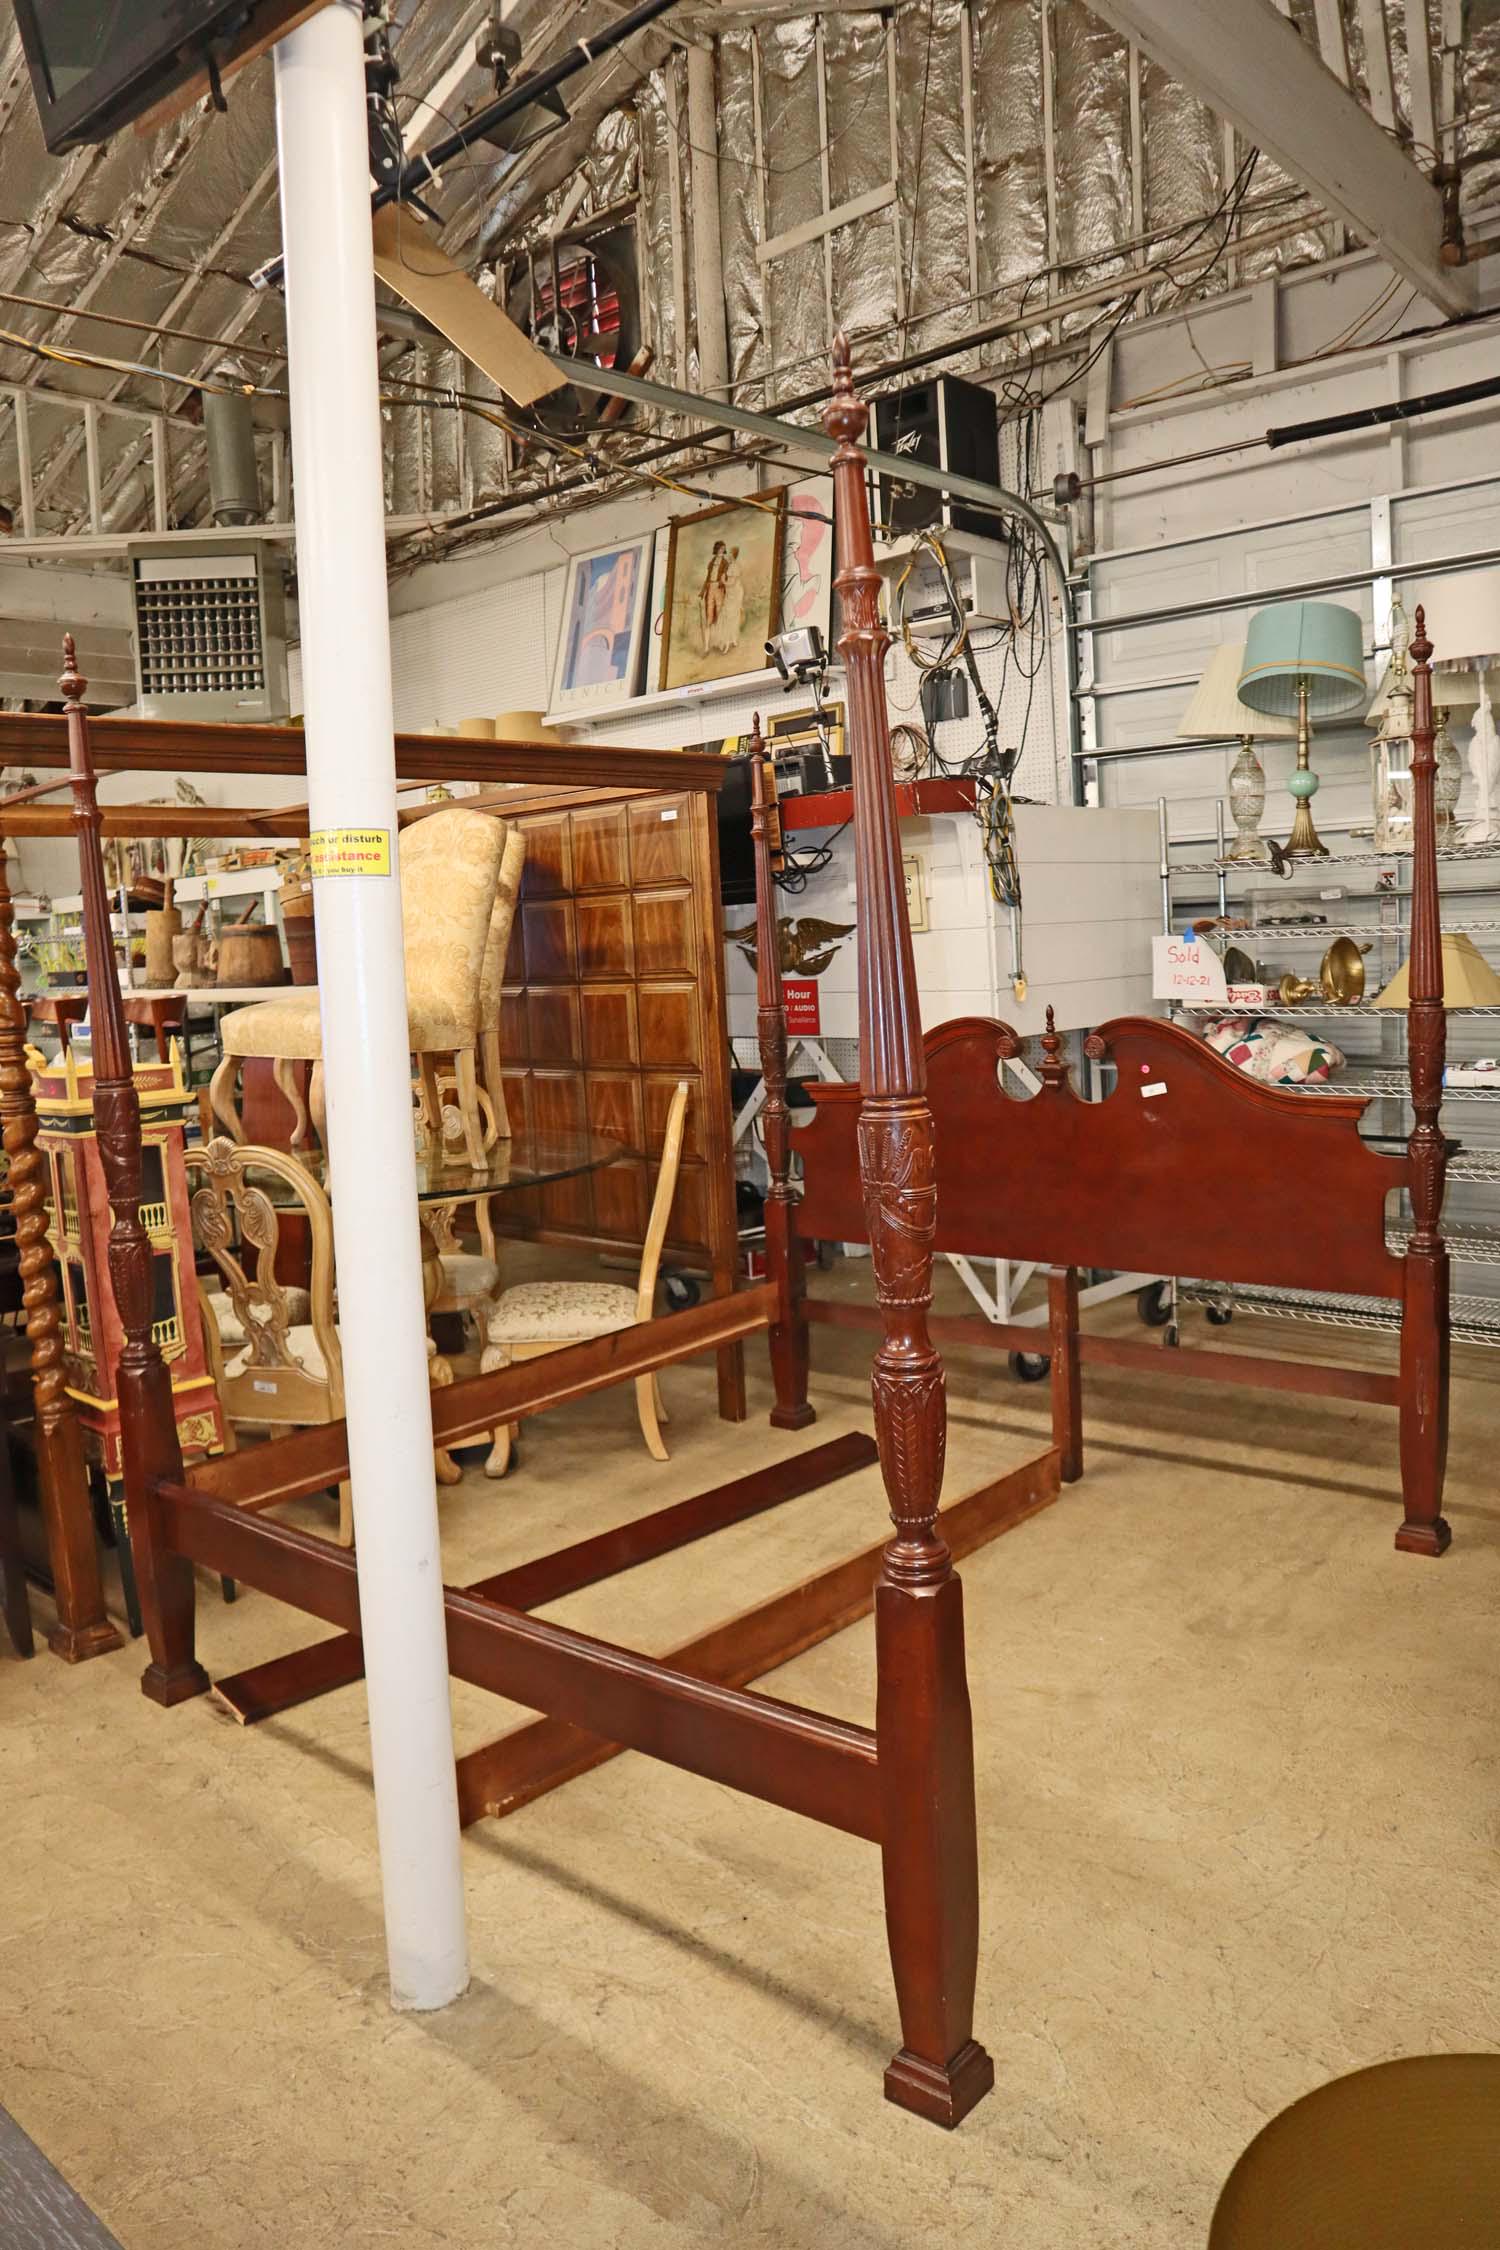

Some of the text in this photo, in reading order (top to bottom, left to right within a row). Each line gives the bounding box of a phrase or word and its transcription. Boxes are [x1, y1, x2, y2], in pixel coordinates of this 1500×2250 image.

[342, 834, 382, 844] disturb
[1167, 945, 1200, 964] Sold
[1173, 974, 1210, 986] 12-12-21
[787, 990, 811, 999] Hour
[794, 1004, 815, 1012] AUDIO
